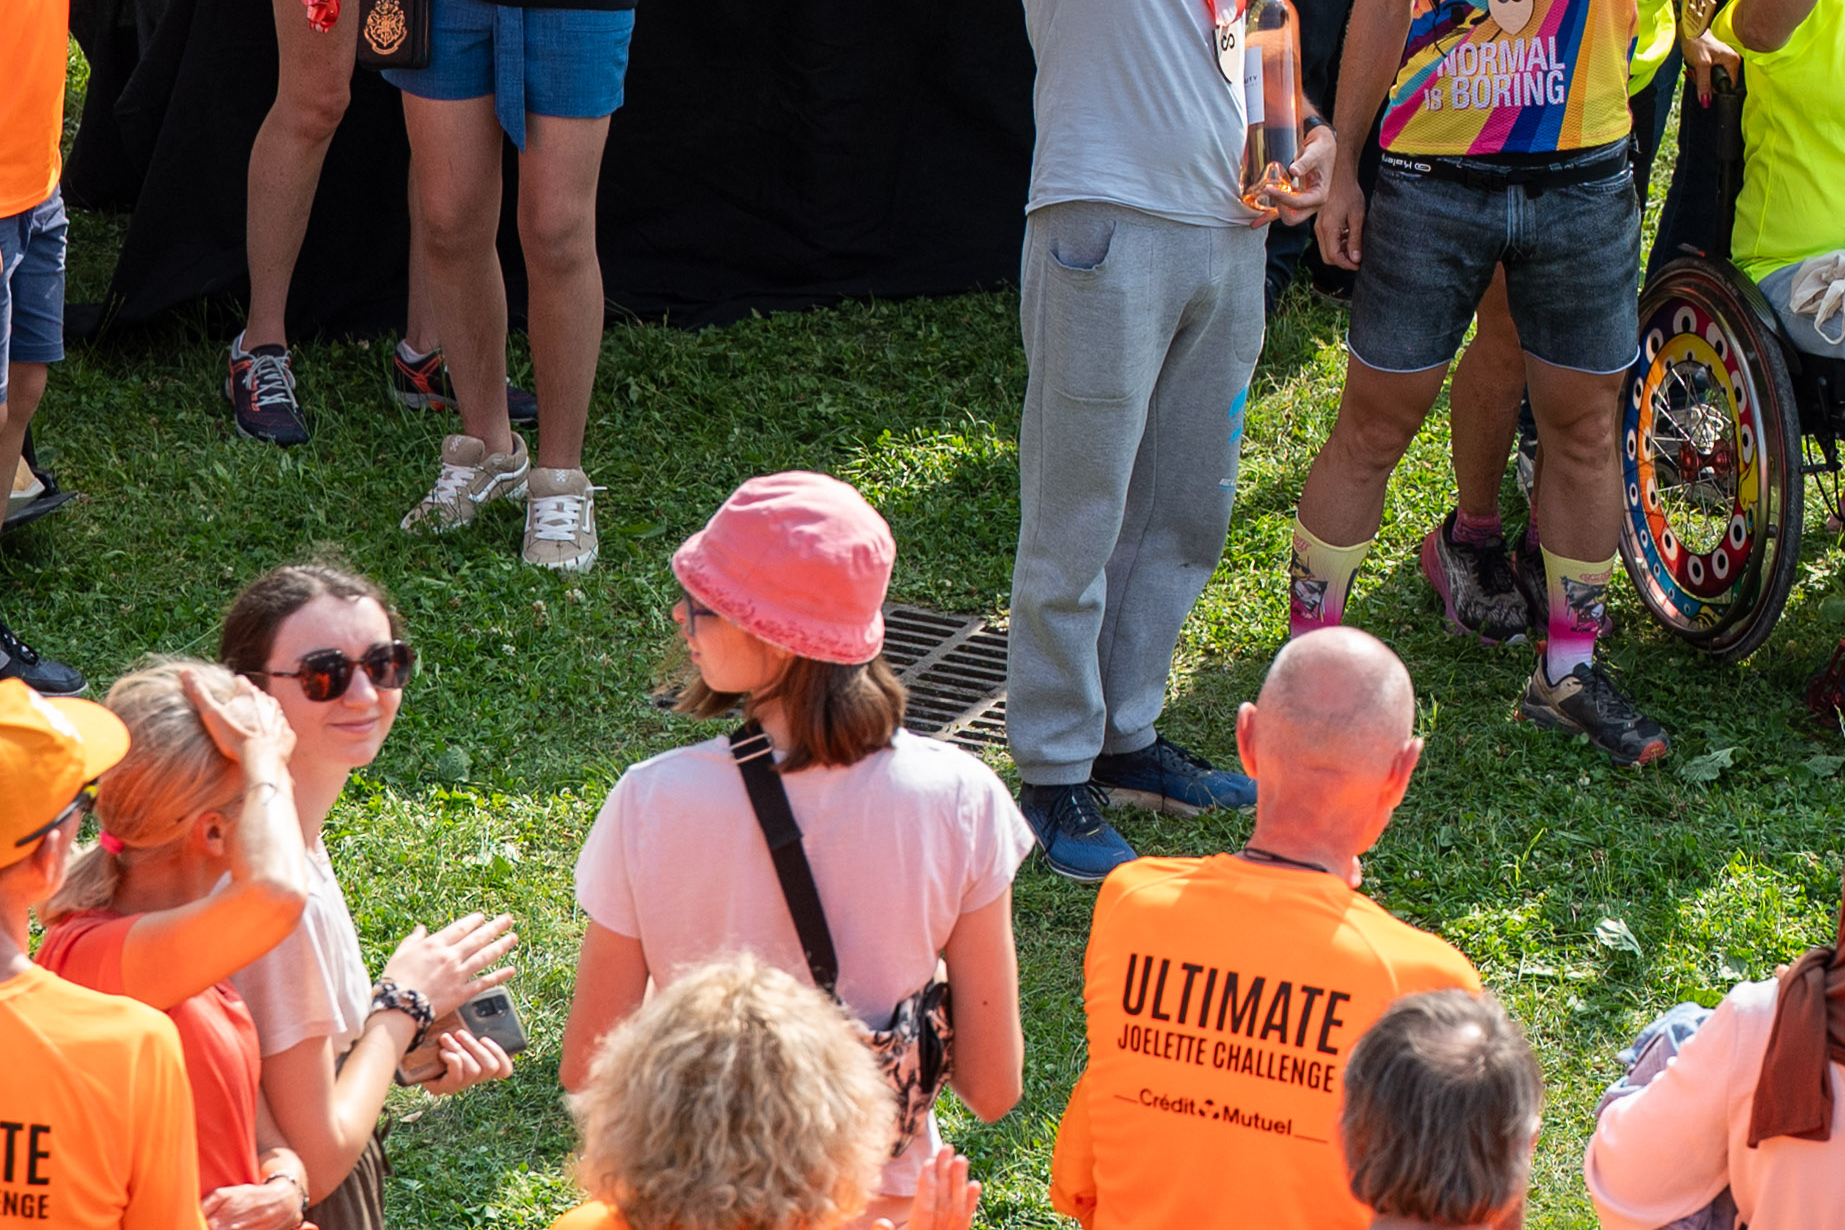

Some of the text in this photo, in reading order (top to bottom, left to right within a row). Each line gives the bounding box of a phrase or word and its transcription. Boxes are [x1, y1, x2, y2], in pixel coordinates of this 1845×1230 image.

[1436, 36, 1566, 78] NORMAL
[1424, 70, 1565, 111] IS BORING
[1122, 953, 1351, 1055] ULTIMATE
[1117, 1022, 1336, 1094] JOELETTE CHALLENGE
[1139, 1087, 1293, 1137] Crédit Mutuel
[0, 1190, 49, 1219] NGE
